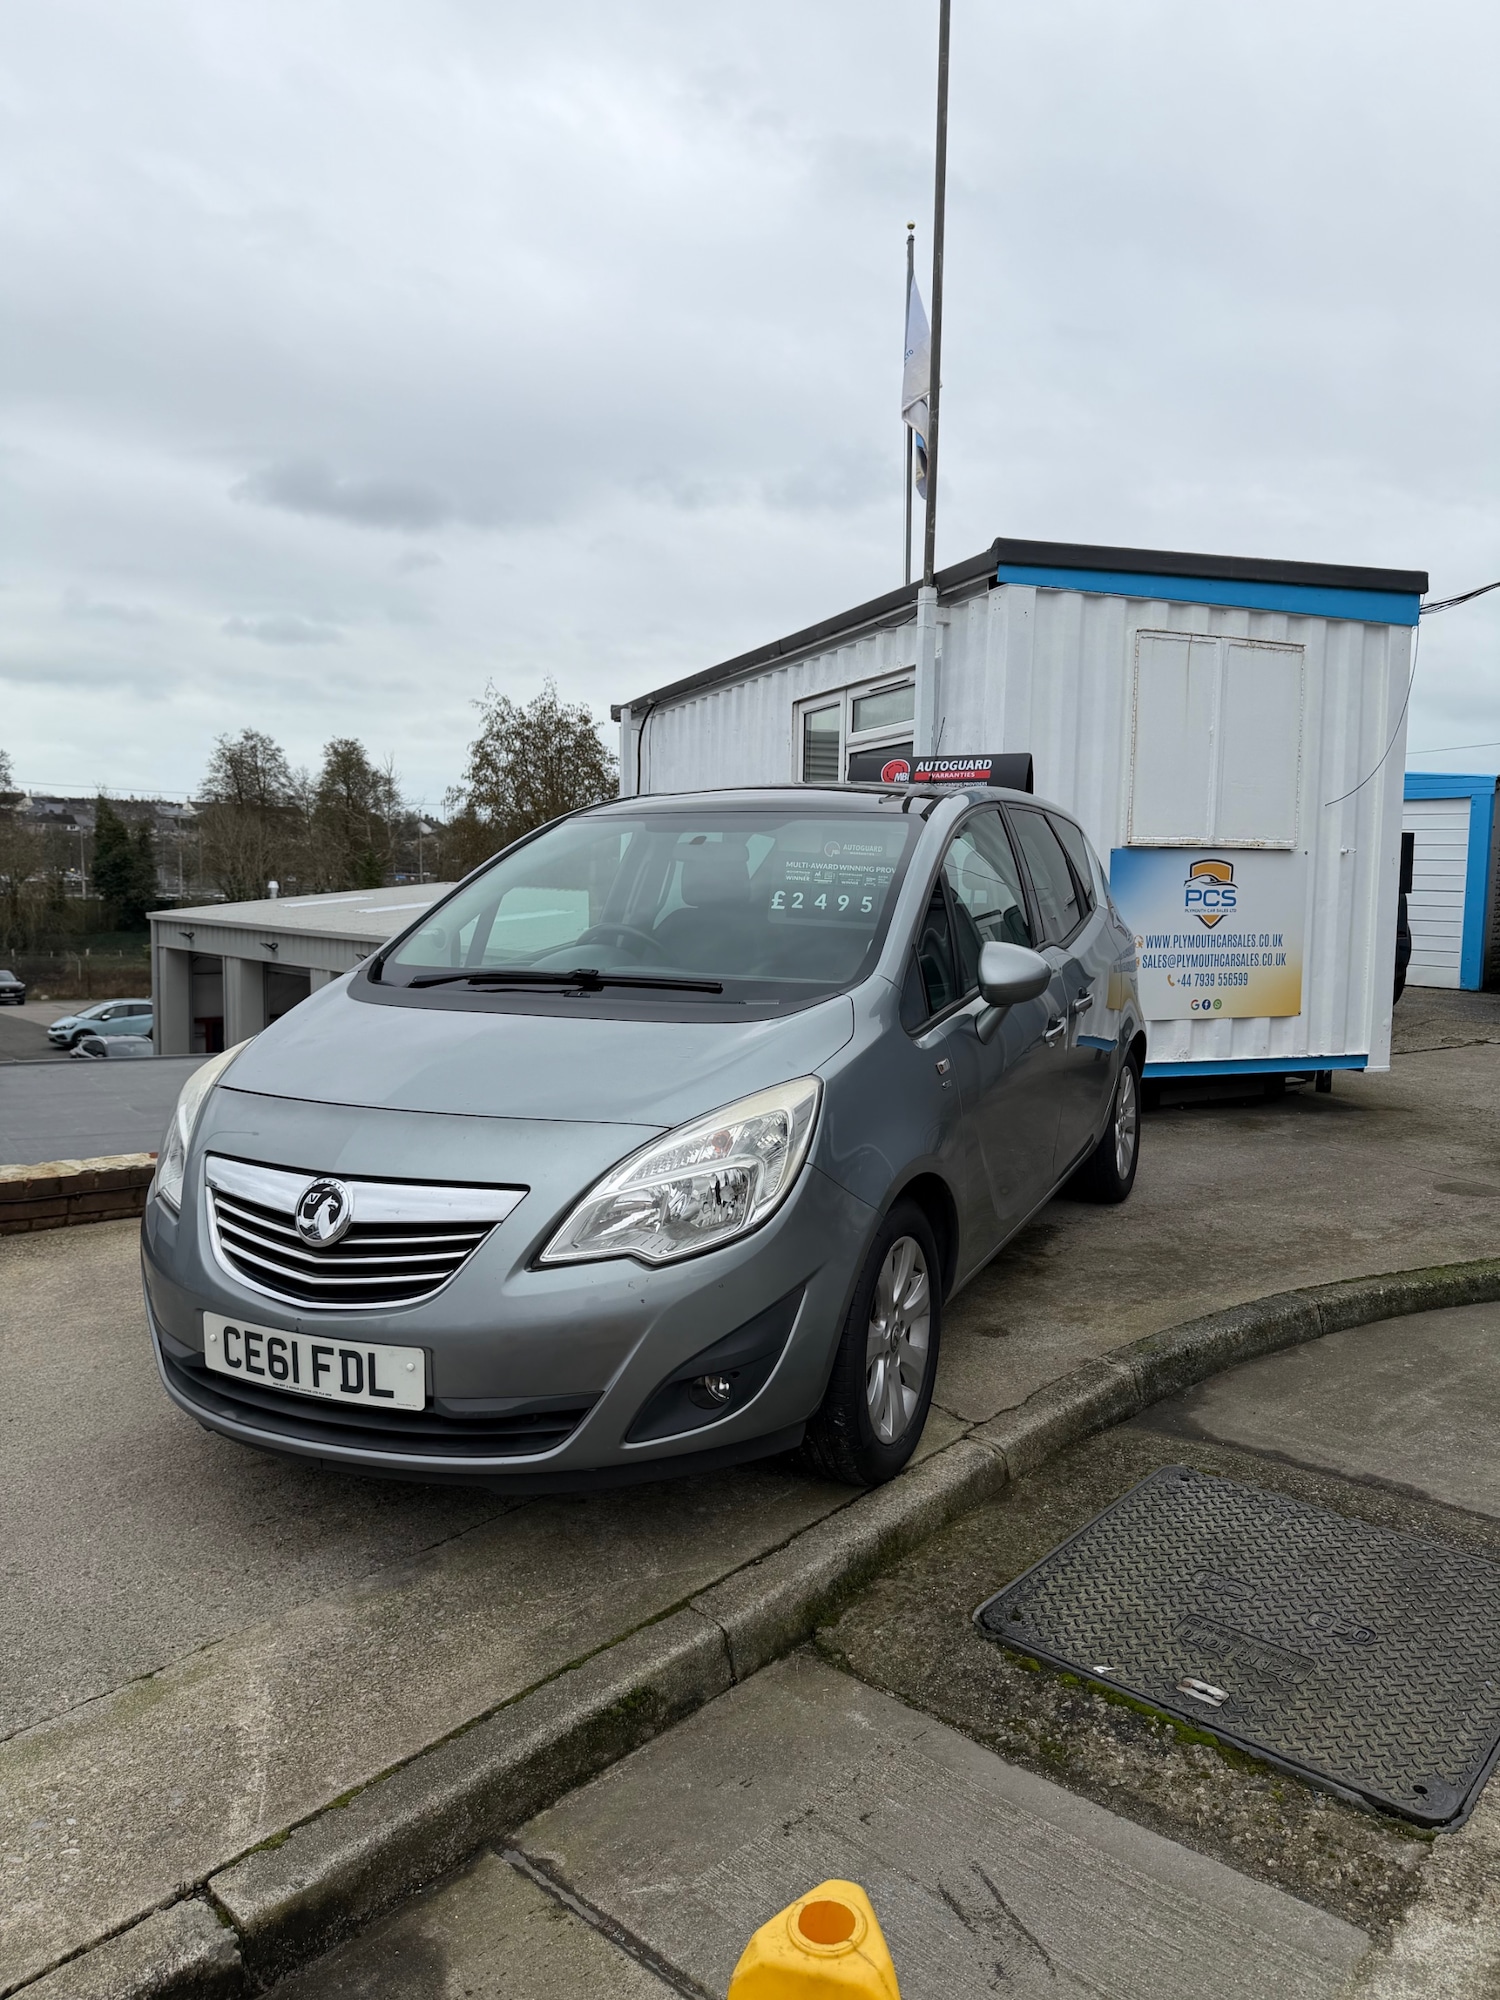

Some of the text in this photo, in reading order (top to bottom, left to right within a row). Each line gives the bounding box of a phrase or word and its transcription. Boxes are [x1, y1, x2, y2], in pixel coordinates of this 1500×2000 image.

[916, 759, 992, 772] AUTOGUARD
[928, 771, 975, 779] WARRANTIES
[842, 843, 883, 853] AUTOGUARD
[839, 864, 875, 873] WINNING
[1185, 889, 1237, 907] PCS
[1145, 933, 1284, 949] WWW.PLYMOUTHCARSALES.CO.UK
[1142, 952, 1287, 969] SALES@PLYMOUTHCARSALES.CO.UK
[1176, 972, 1248, 987] +44 7939 556599
[223, 1325, 394, 1399] CE61 FDL
[1314, 1614, 1371, 1643] 950
